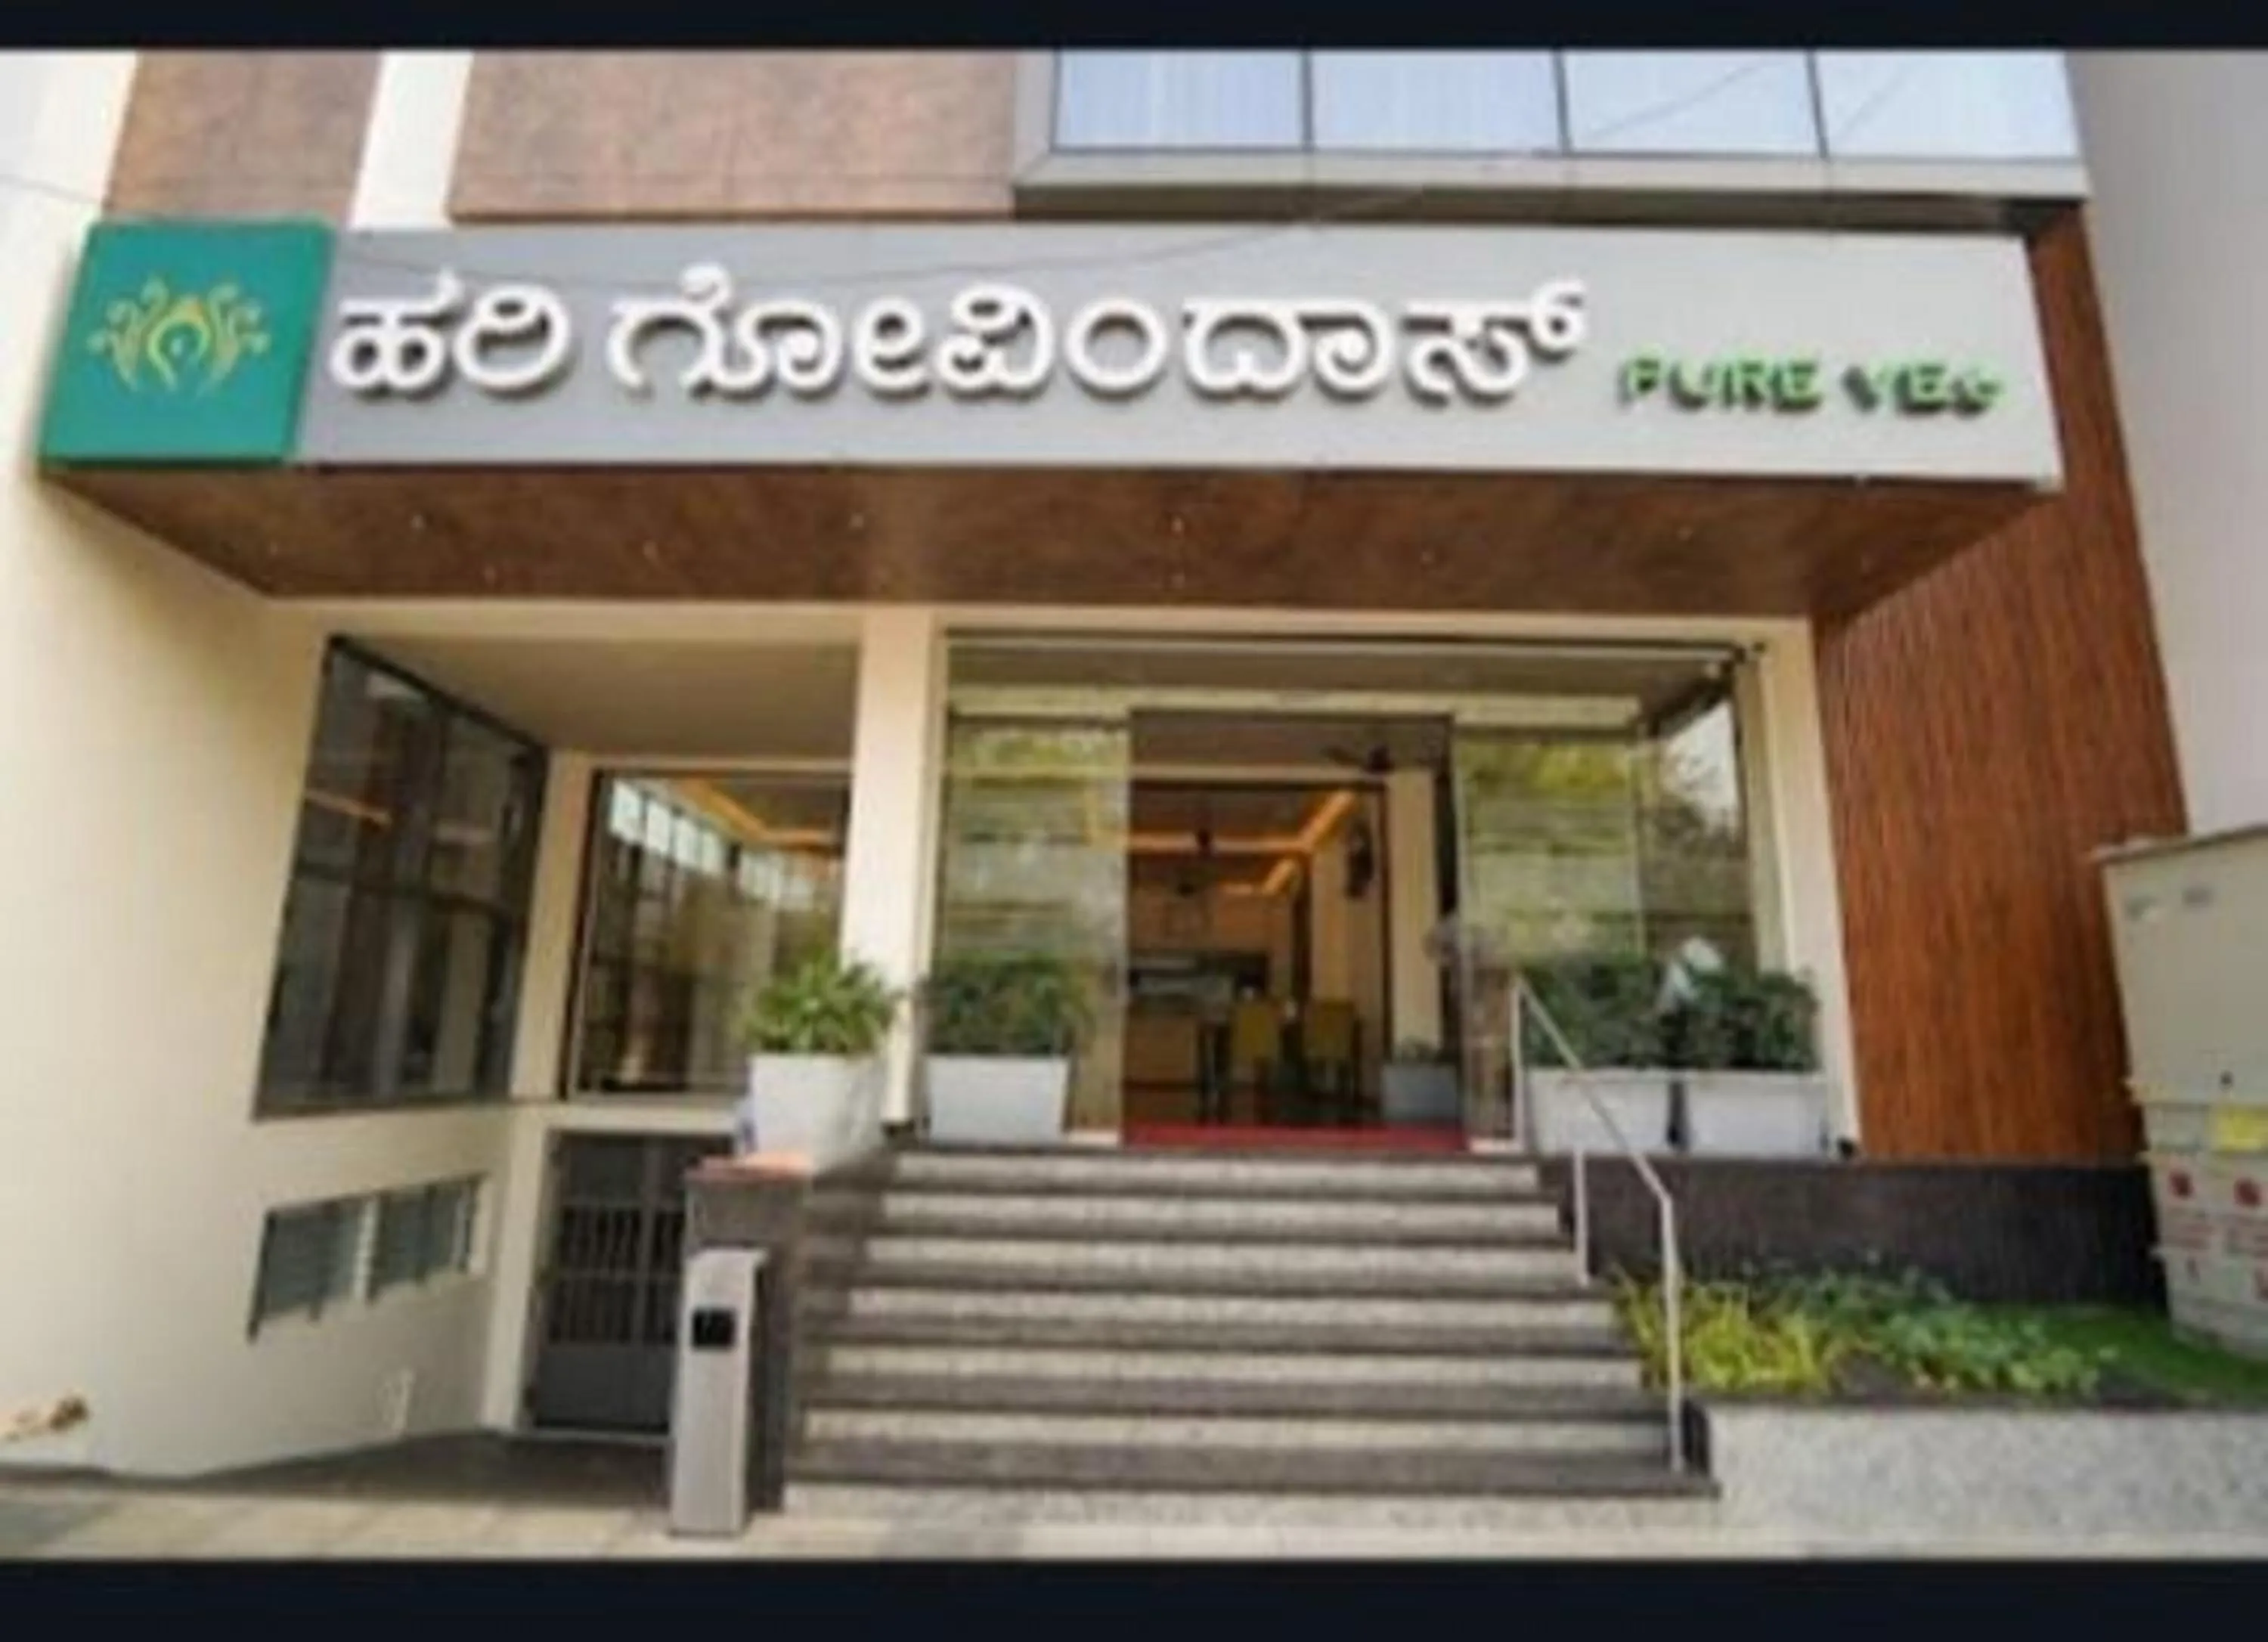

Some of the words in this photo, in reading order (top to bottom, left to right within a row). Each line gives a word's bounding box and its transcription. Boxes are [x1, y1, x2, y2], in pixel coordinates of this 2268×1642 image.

[330, 265, 573, 393] ಹರಿ
[608, 262, 1588, 398] ಗೋವಿಂದಾಸ್
[1616, 346, 1822, 413] PURE
[1840, 352, 2005, 417] VEG
